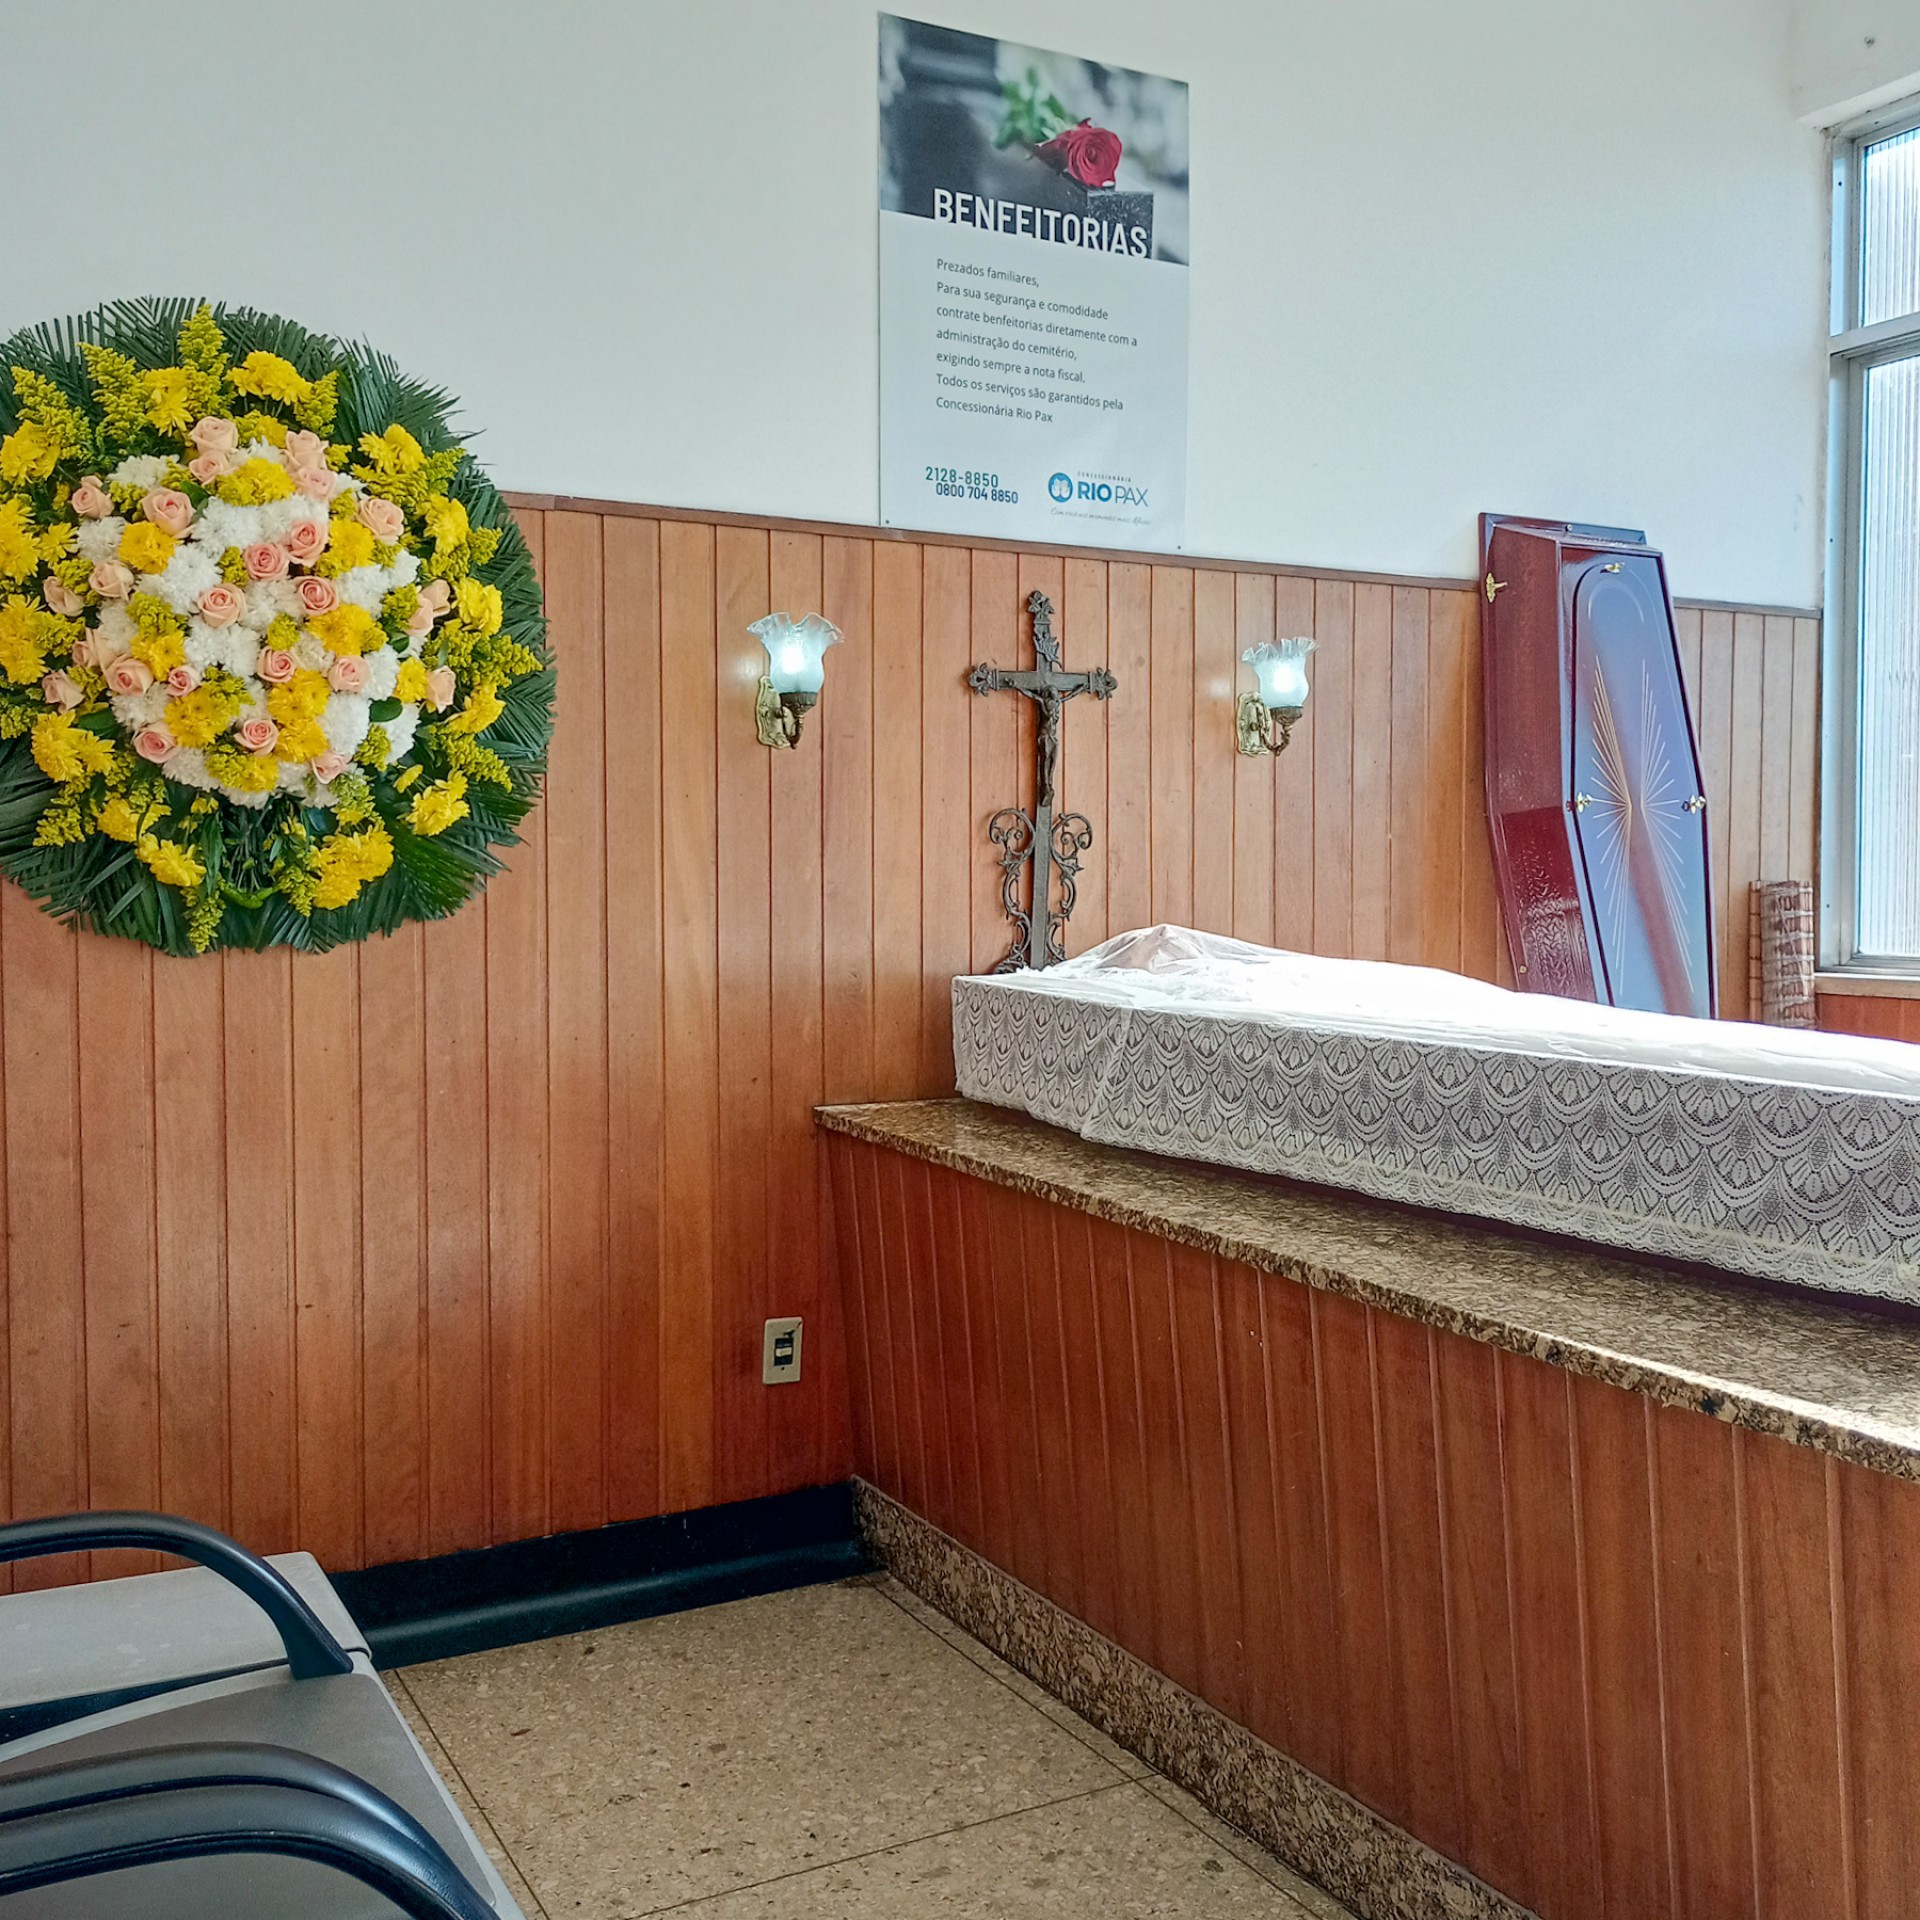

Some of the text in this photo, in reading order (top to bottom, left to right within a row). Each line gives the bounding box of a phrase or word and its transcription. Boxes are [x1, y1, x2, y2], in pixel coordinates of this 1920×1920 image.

[933, 188, 1149, 259] BENFEITORIAS
[936, 258, 1040, 288] Prezados familiares,
[936, 282, 1109, 320] Para sua segurança e comodidade
[936, 307, 1138, 346] contrate benfeitorias diretamente com a
[936, 328, 1078, 361] administração do cemitério,
[936, 353, 981, 369] exigindo
[982, 360, 1022, 376] sempre
[1024, 366, 1031, 375] a
[1032, 367, 1056, 379] nota
[936, 373, 1124, 412] Todos os serviços são garantidos pela
[936, 397, 1053, 423] Concessionária Rio Pax
[925, 466, 999, 488] 2128-8850
[936, 482, 1018, 504] 0800 704 8850
[1077, 480, 1149, 508] RIO PAX
